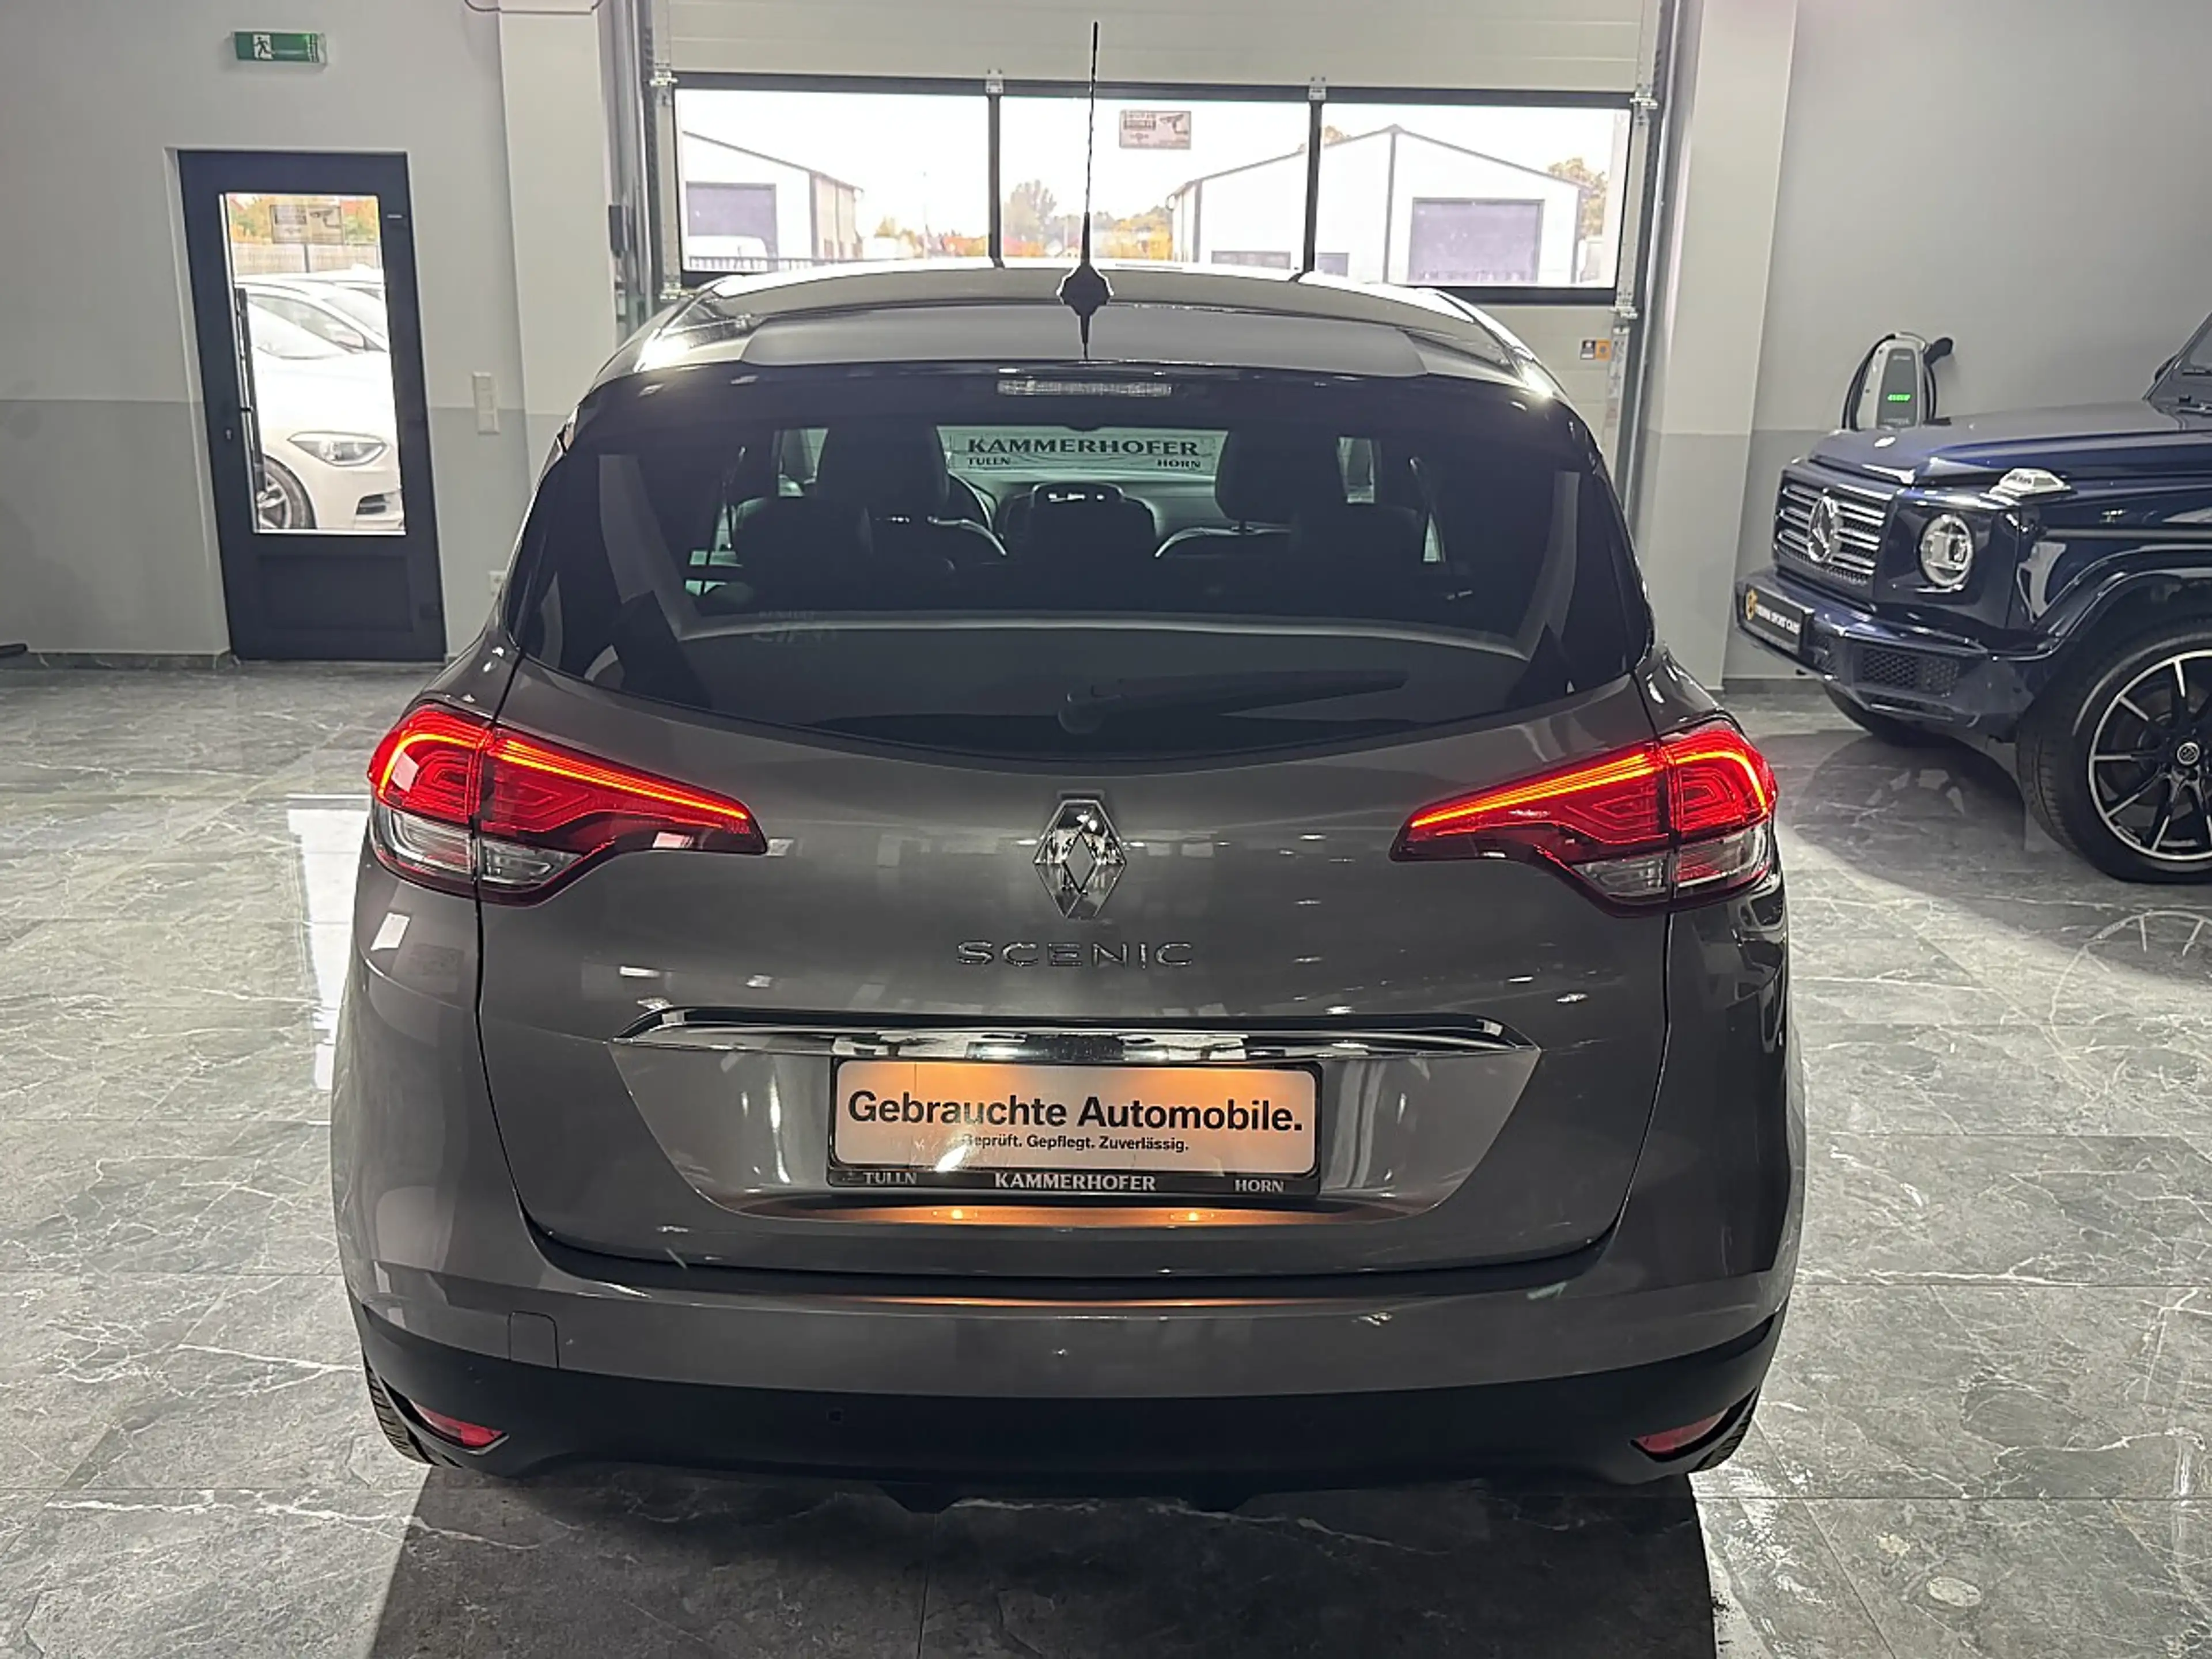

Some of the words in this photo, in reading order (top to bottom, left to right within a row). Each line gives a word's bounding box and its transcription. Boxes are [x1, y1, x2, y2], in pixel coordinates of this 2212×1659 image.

[968, 438, 1199, 456] KAMMERHOFER
[968, 457, 1010, 465] TULLN
[1157, 459, 1201, 468] HORN
[956, 940, 1193, 968] SCENIC
[848, 1090, 1067, 1127] Gebrauchte
[1077, 1096, 1303, 1131] Automobile.
[1027, 1134, 1095, 1151] Gepflegt.
[1099, 1135, 1189, 1153] Zuverlässig.
[863, 1172, 918, 1185] TULLN
[995, 1173, 1156, 1191] KAMMERHOFER
[1234, 1179, 1285, 1193] HORN
